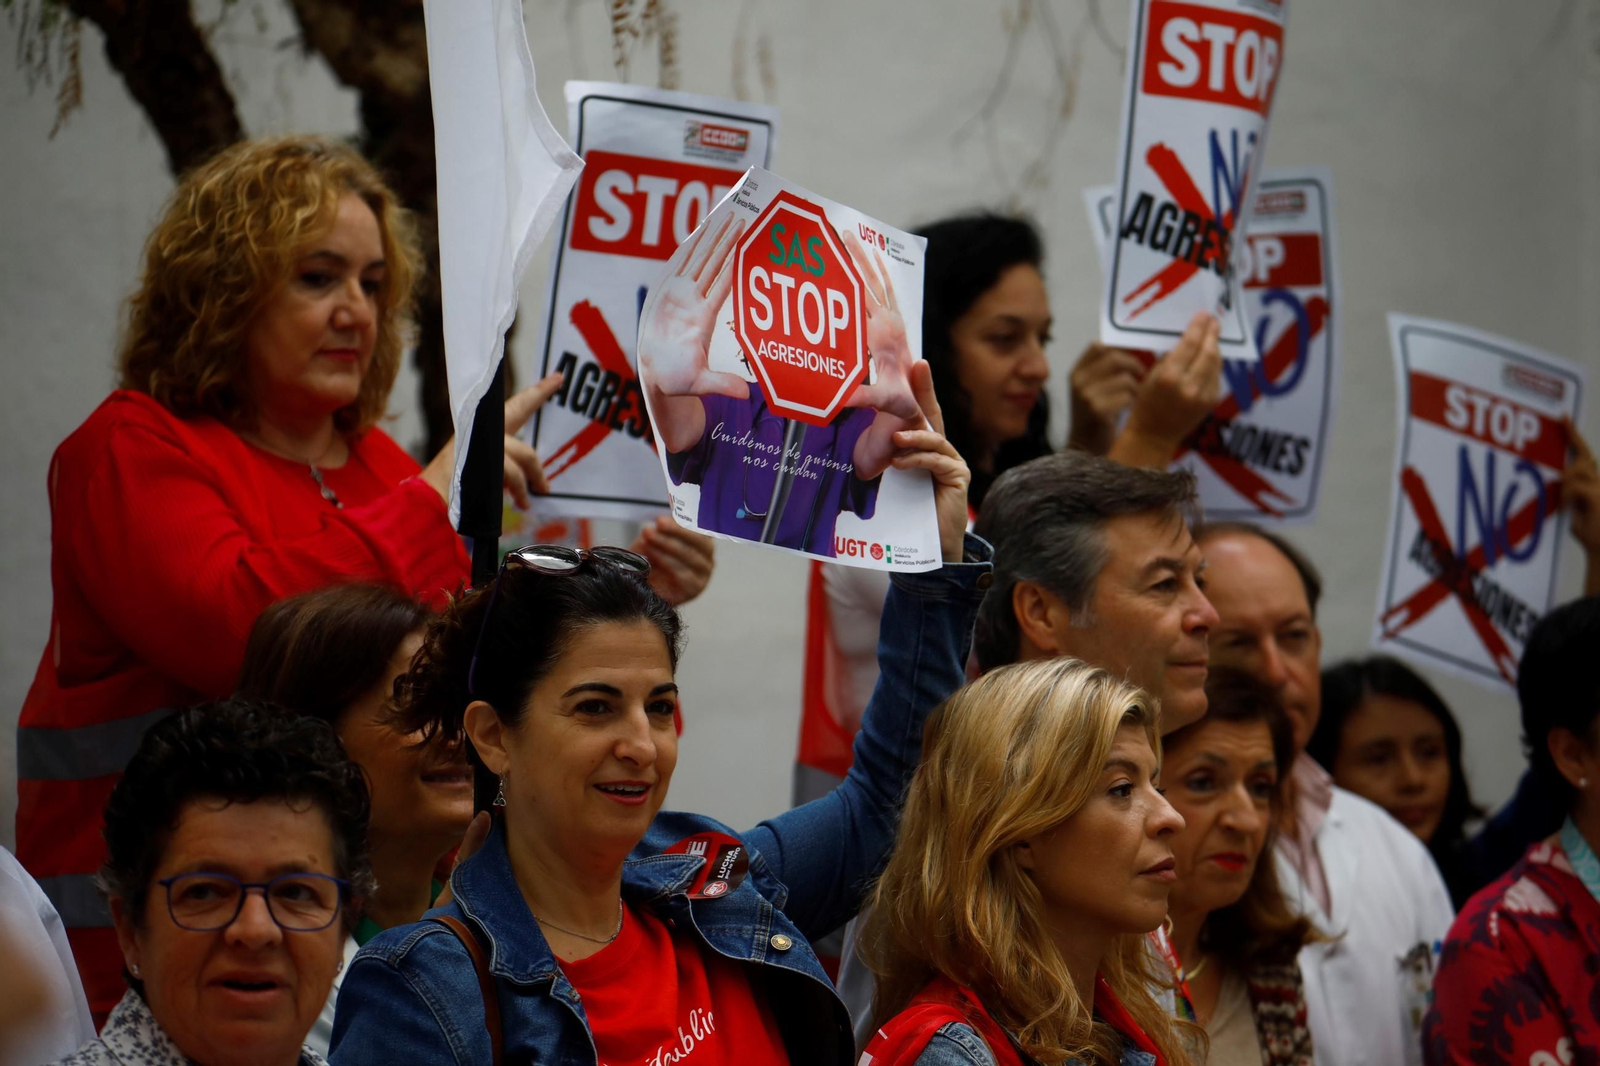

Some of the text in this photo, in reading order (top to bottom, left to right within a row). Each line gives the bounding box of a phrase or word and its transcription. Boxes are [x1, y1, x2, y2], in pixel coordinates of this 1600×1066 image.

[1157, 17, 1280, 102] STOP
[768, 222, 826, 277] SAS
[858, 222, 877, 246] UGT
[748, 265, 850, 350] STOP
[757, 338, 846, 380] AGRESIONES
[1443, 384, 1541, 450] STOP
[742, 454, 819, 481] nos cuidan
[785, 441, 801, 460] de
[803, 453, 854, 474] quienes
[1457, 443, 1546, 569] NO
[835, 536, 867, 558] UGT
[717, 850, 735, 879] LUCHA
